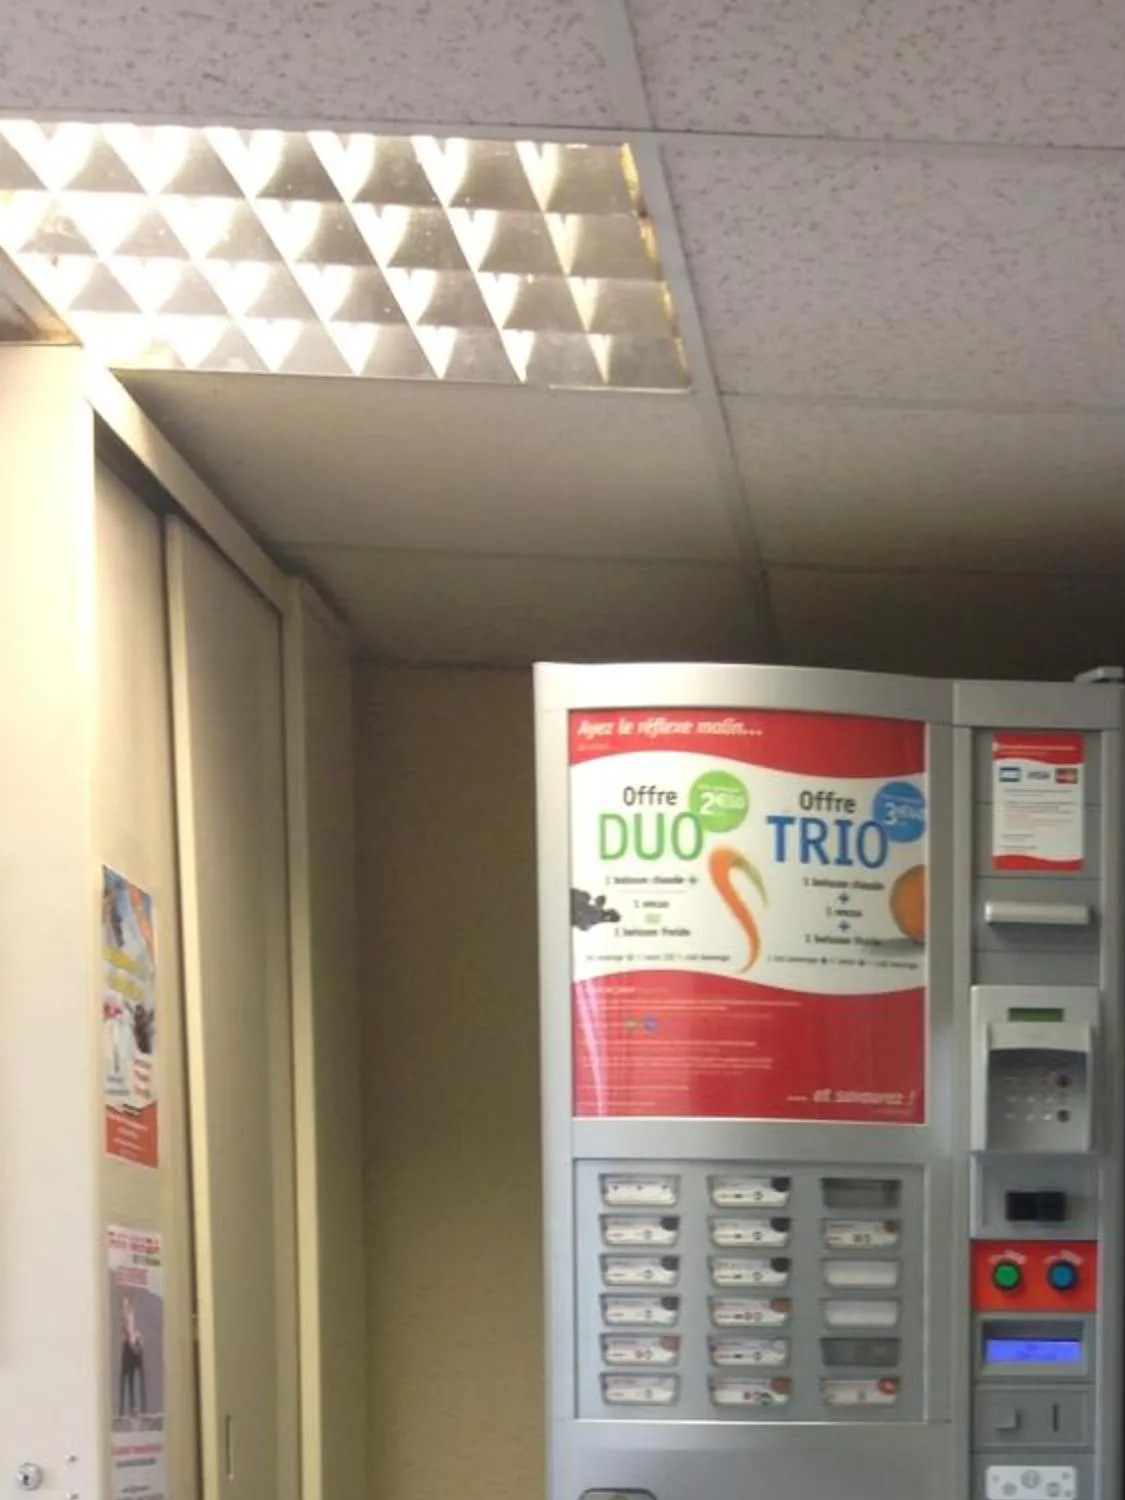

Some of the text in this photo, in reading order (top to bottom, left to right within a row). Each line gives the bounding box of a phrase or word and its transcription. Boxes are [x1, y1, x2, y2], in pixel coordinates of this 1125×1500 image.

[623, 785, 678, 807] Offre
[799, 790, 855, 815] Offre
[599, 812, 703, 861] DUO
[766, 815, 888, 869] TRIO
